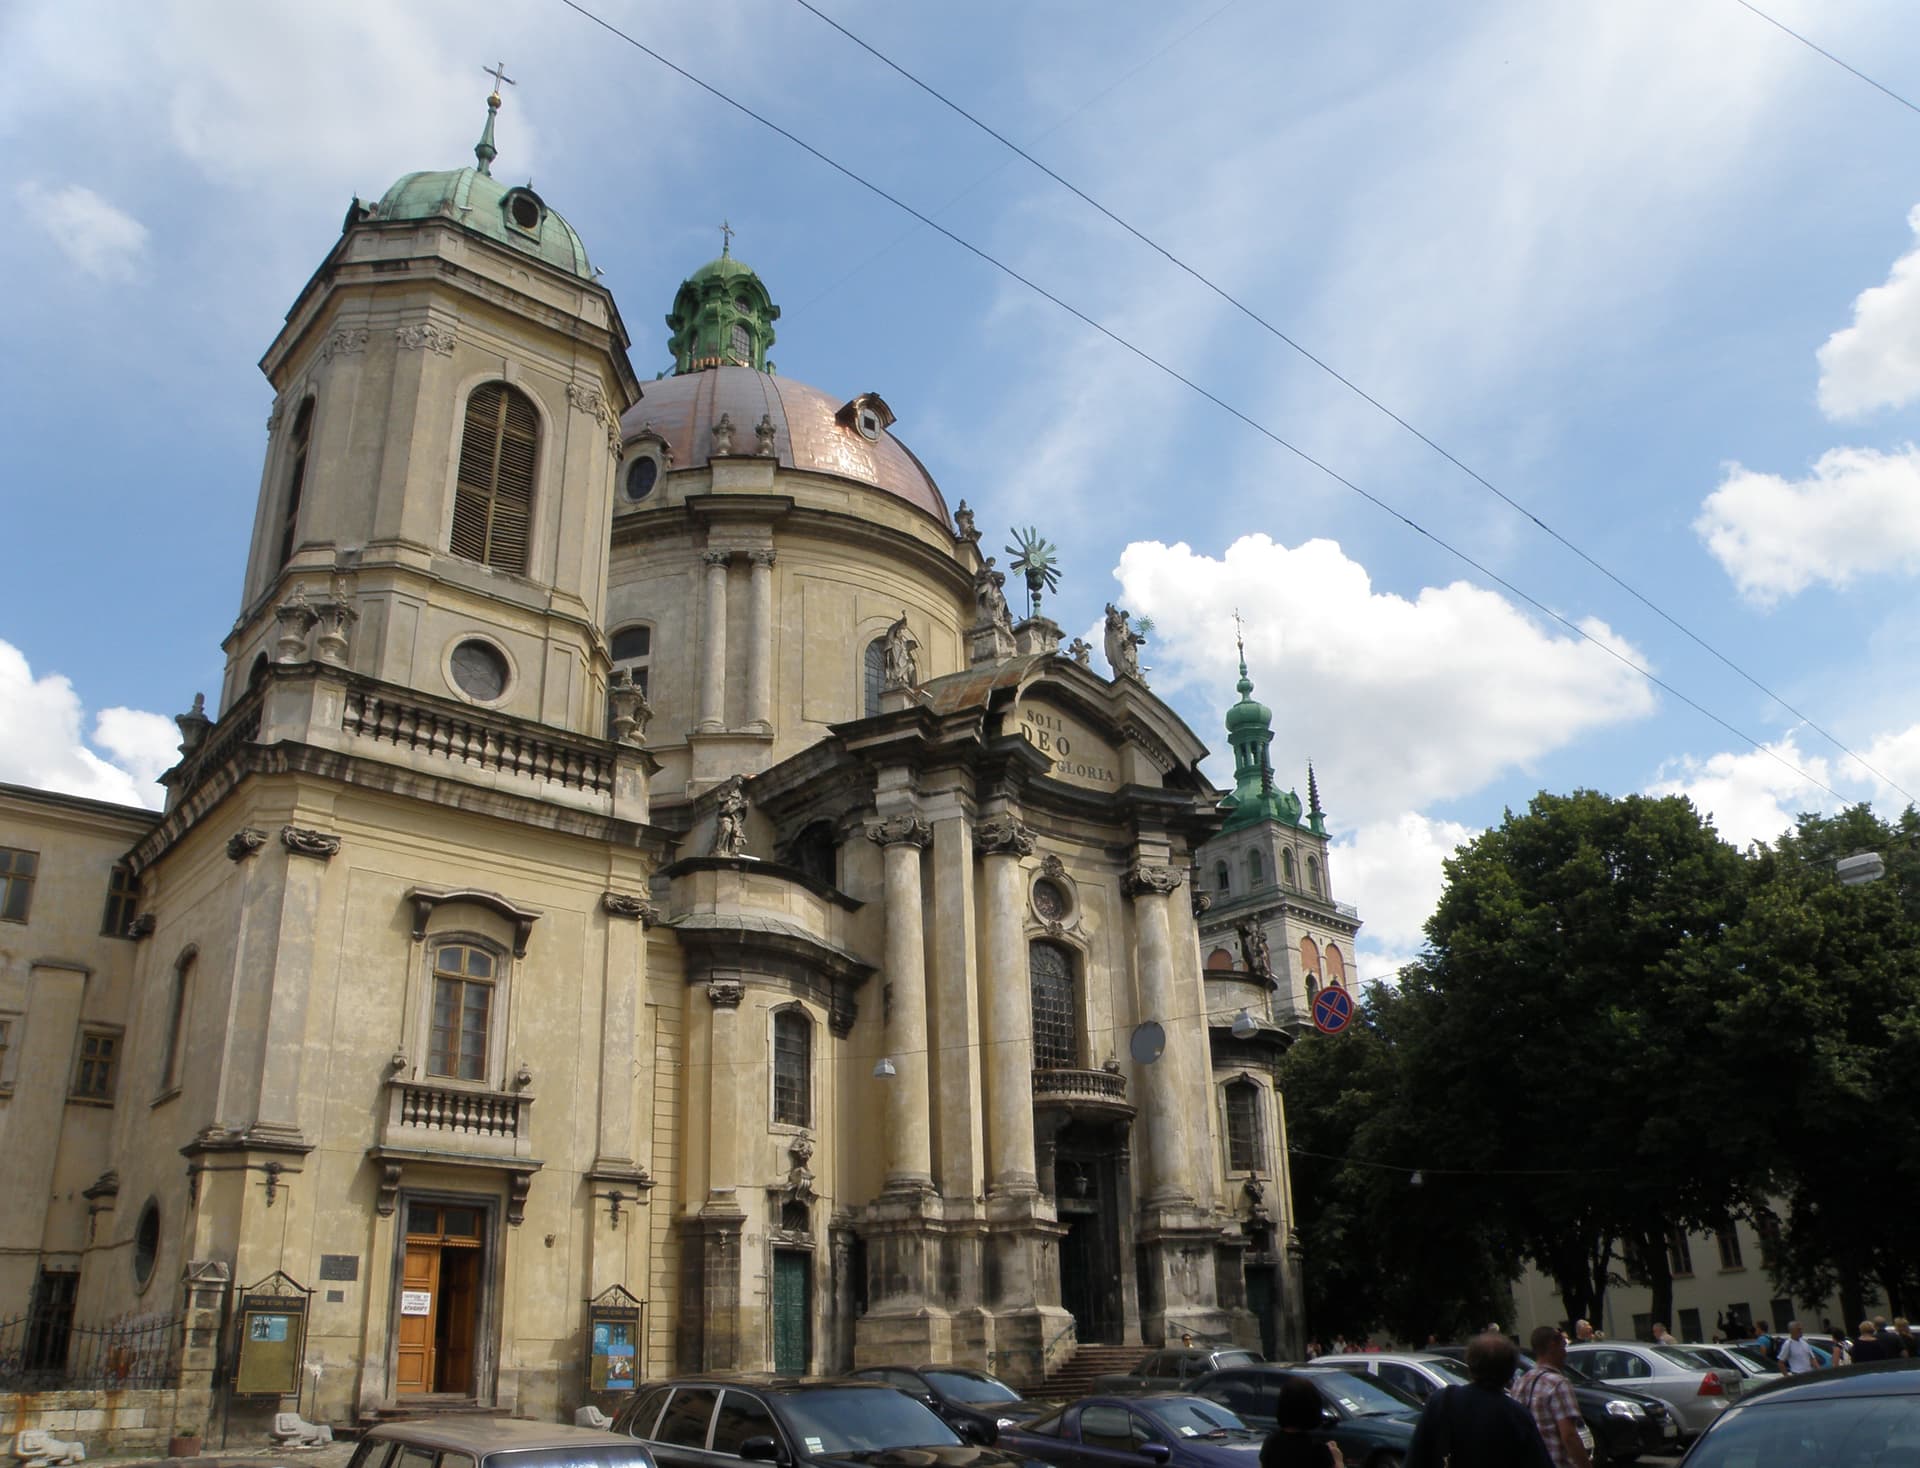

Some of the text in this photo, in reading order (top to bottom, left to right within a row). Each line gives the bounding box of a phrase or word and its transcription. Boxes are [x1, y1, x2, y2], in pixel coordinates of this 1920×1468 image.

[1027, 709, 1062, 732] SOLI
[1020, 722, 1070, 757] DEO
[1056, 760, 1114, 781] GLORIA
